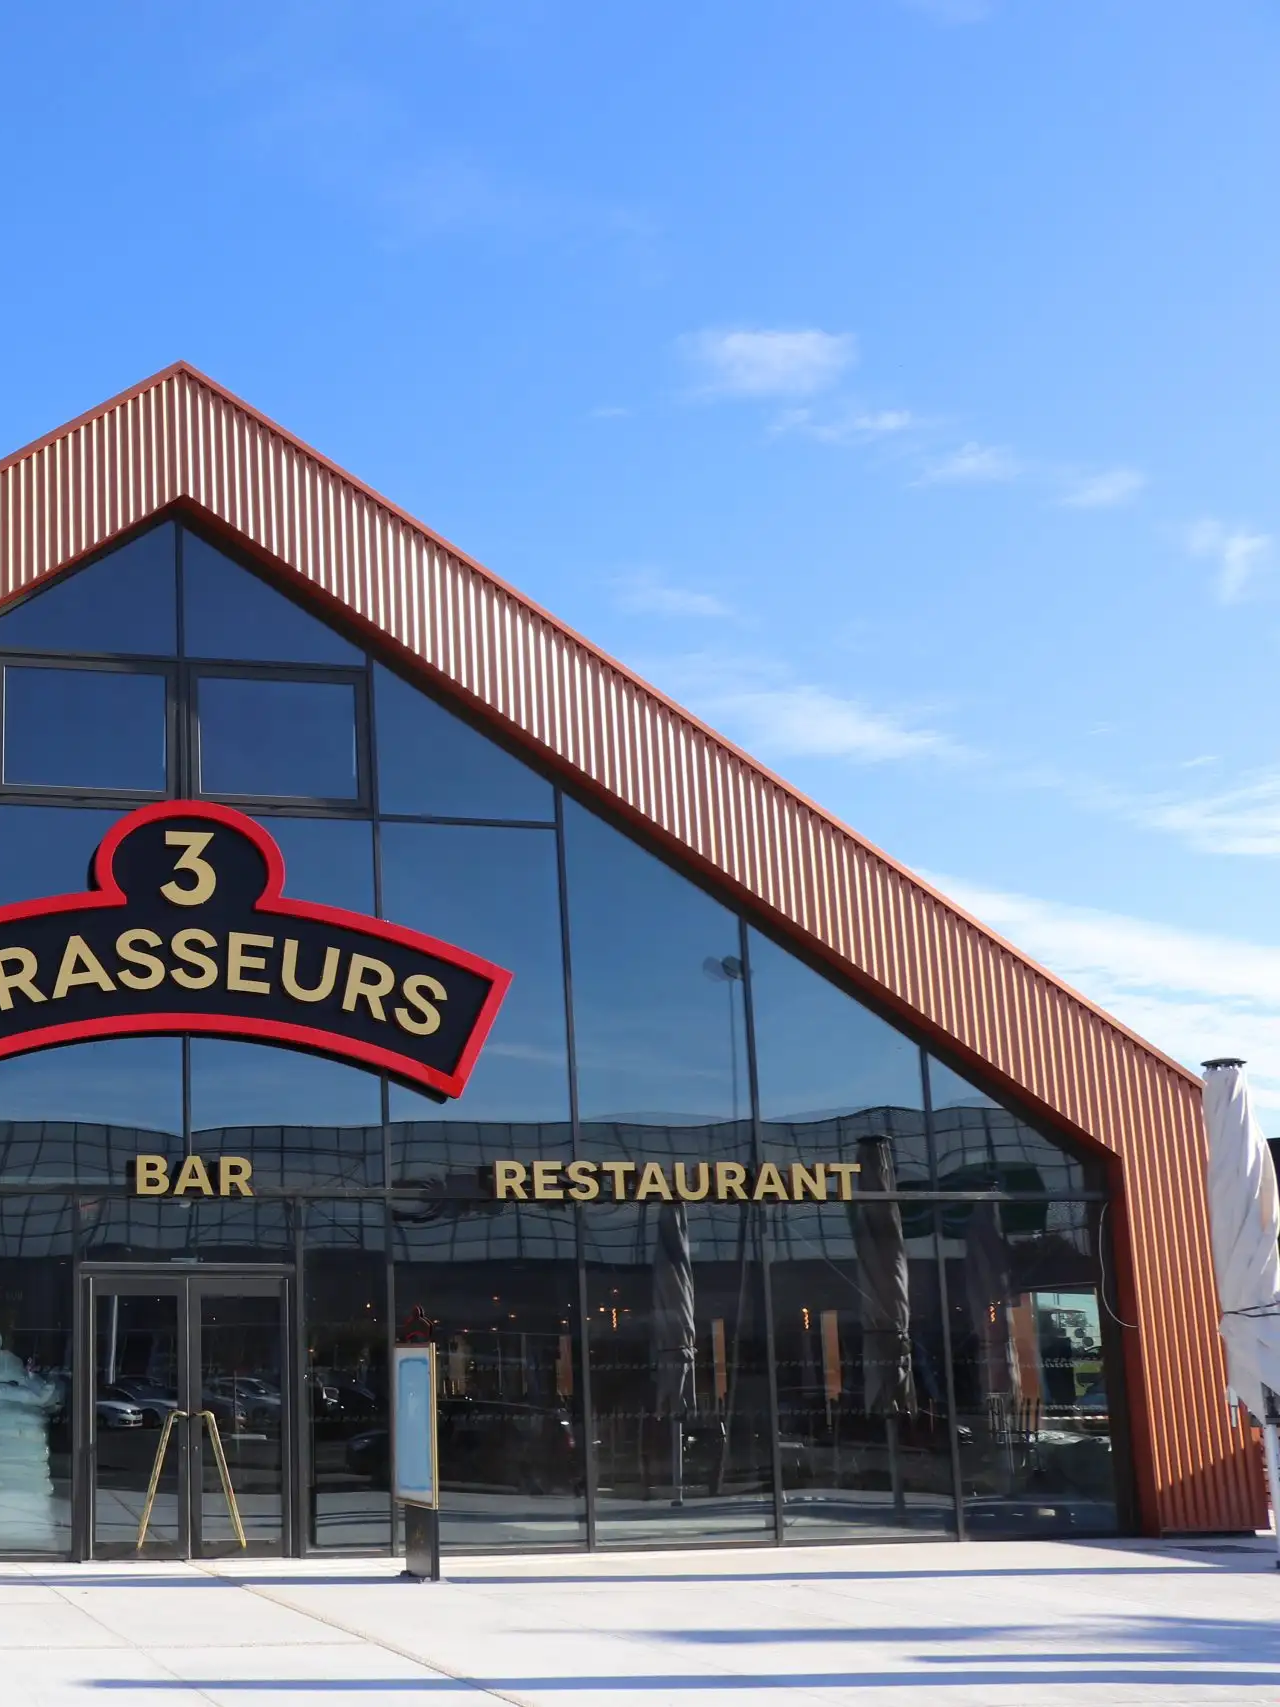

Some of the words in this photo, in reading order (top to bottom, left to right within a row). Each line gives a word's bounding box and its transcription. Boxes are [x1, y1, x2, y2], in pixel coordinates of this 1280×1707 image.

[160, 831, 217, 906] 3
[136, 1155, 255, 1198] BAR
[495, 1160, 861, 1200] RESTAURANT
